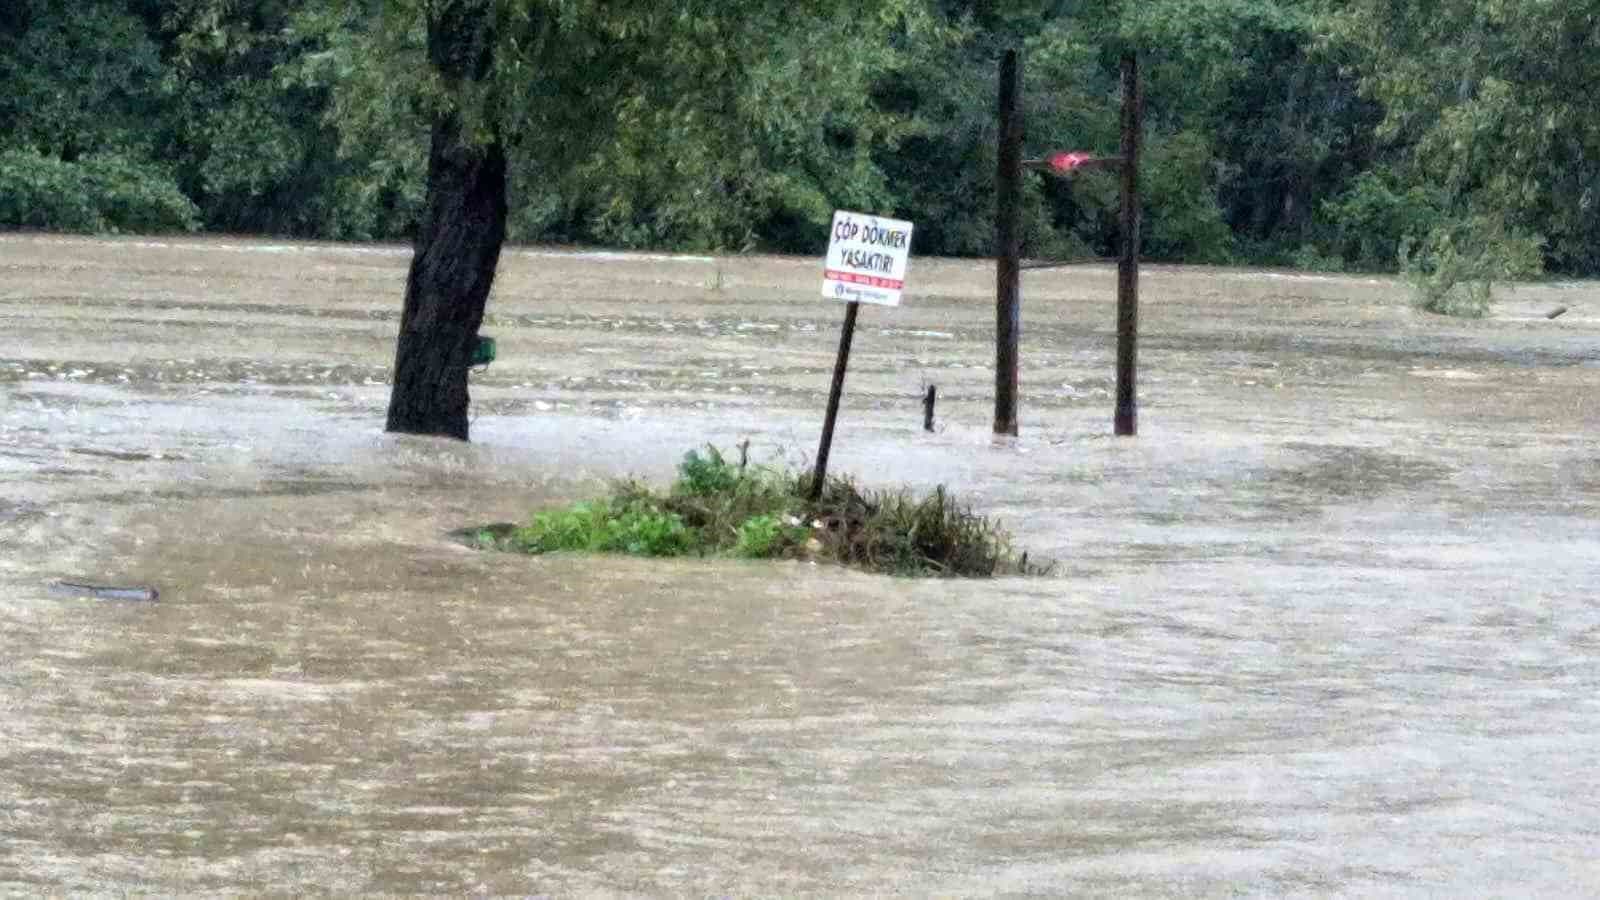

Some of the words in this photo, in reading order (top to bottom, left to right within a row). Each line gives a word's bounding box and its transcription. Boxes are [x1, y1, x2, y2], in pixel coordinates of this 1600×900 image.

[835, 217, 858, 243] ÇÖP
[862, 219, 908, 249] DÖKMEK
[841, 248, 894, 273] YASAKTIR!
